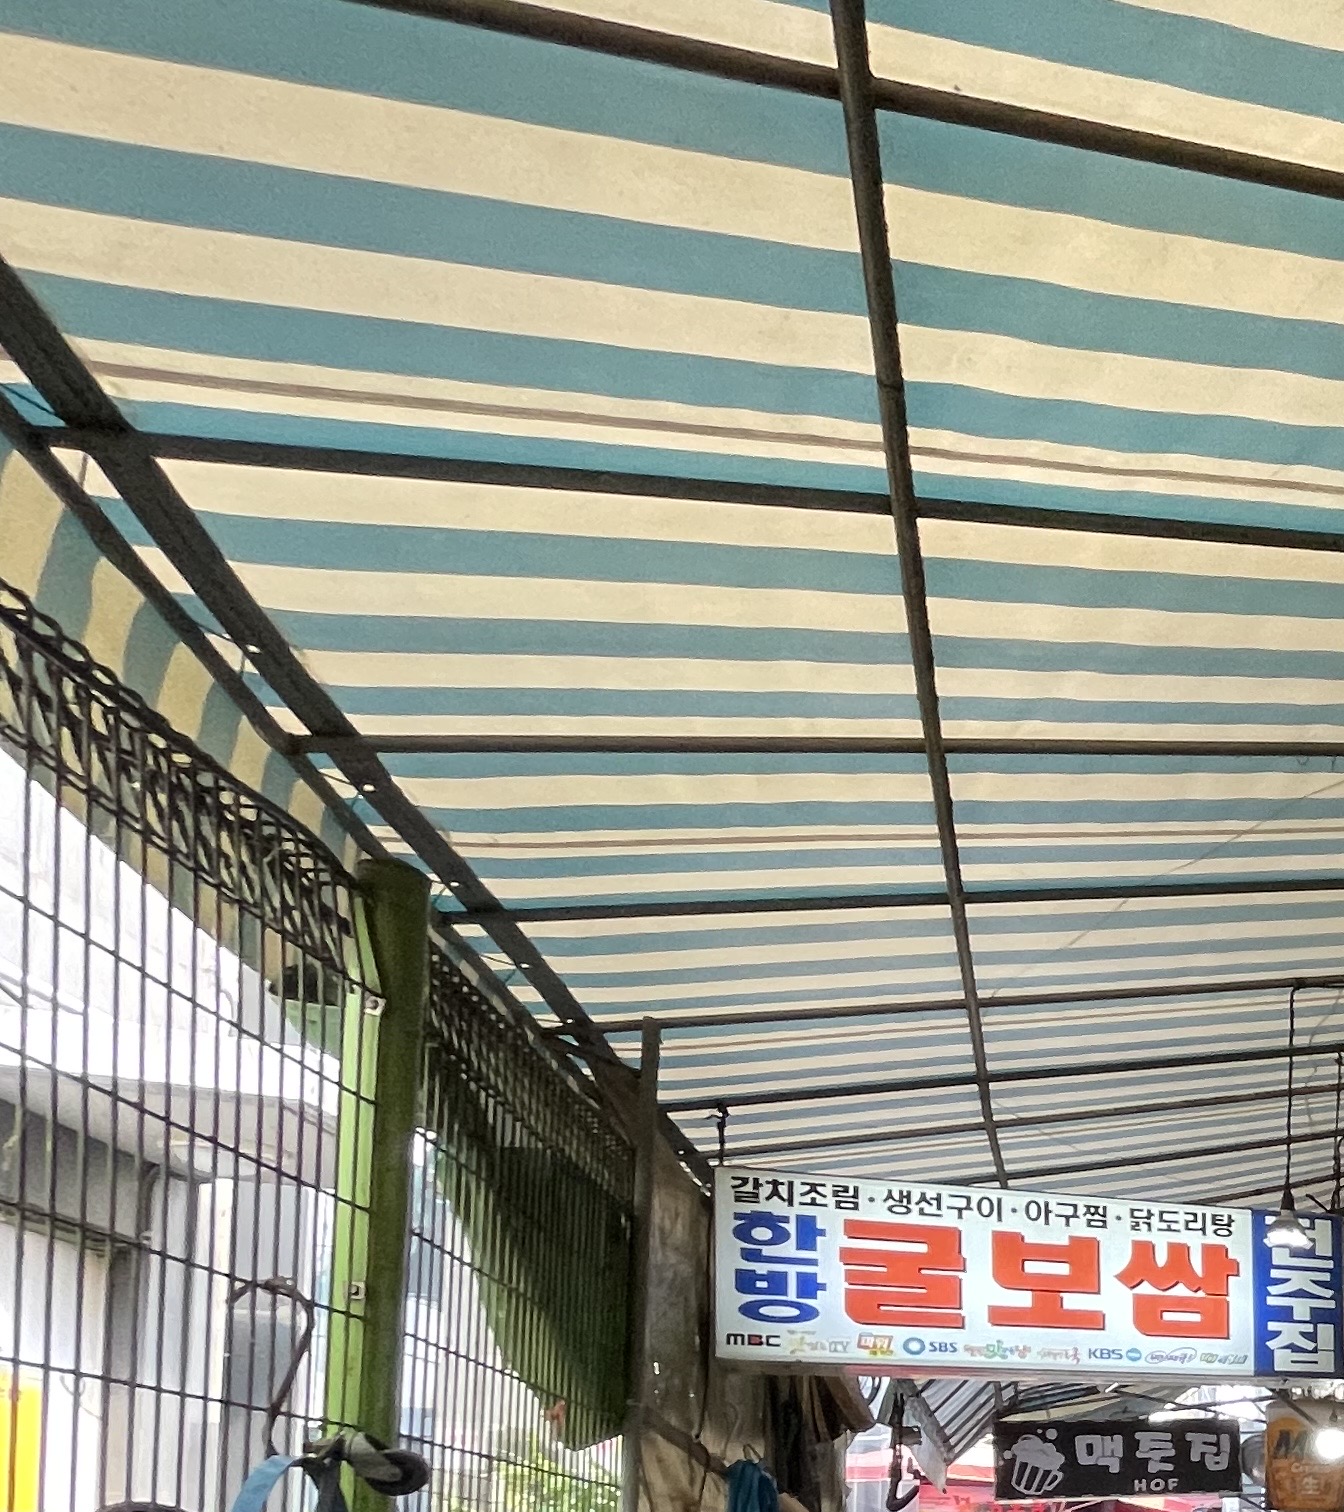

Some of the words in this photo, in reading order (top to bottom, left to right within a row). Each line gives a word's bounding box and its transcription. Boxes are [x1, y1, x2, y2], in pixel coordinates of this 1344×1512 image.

[730, 1176, 861, 1211] 갈치조림
[883, 1187, 1004, 1223] 생선구이
[1024, 1198, 1109, 1230] 아구찜
[1128, 1207, 1236, 1239] 닭도리탕
[731, 1210, 828, 1324] 한방
[838, 1218, 1240, 1340] 굴보쌈
[725, 1332, 782, 1348] MBC
[929, 1341, 959, 1353] SBS
[1088, 1347, 1123, 1360] KBS
[1133, 1478, 1180, 1493] HOF
